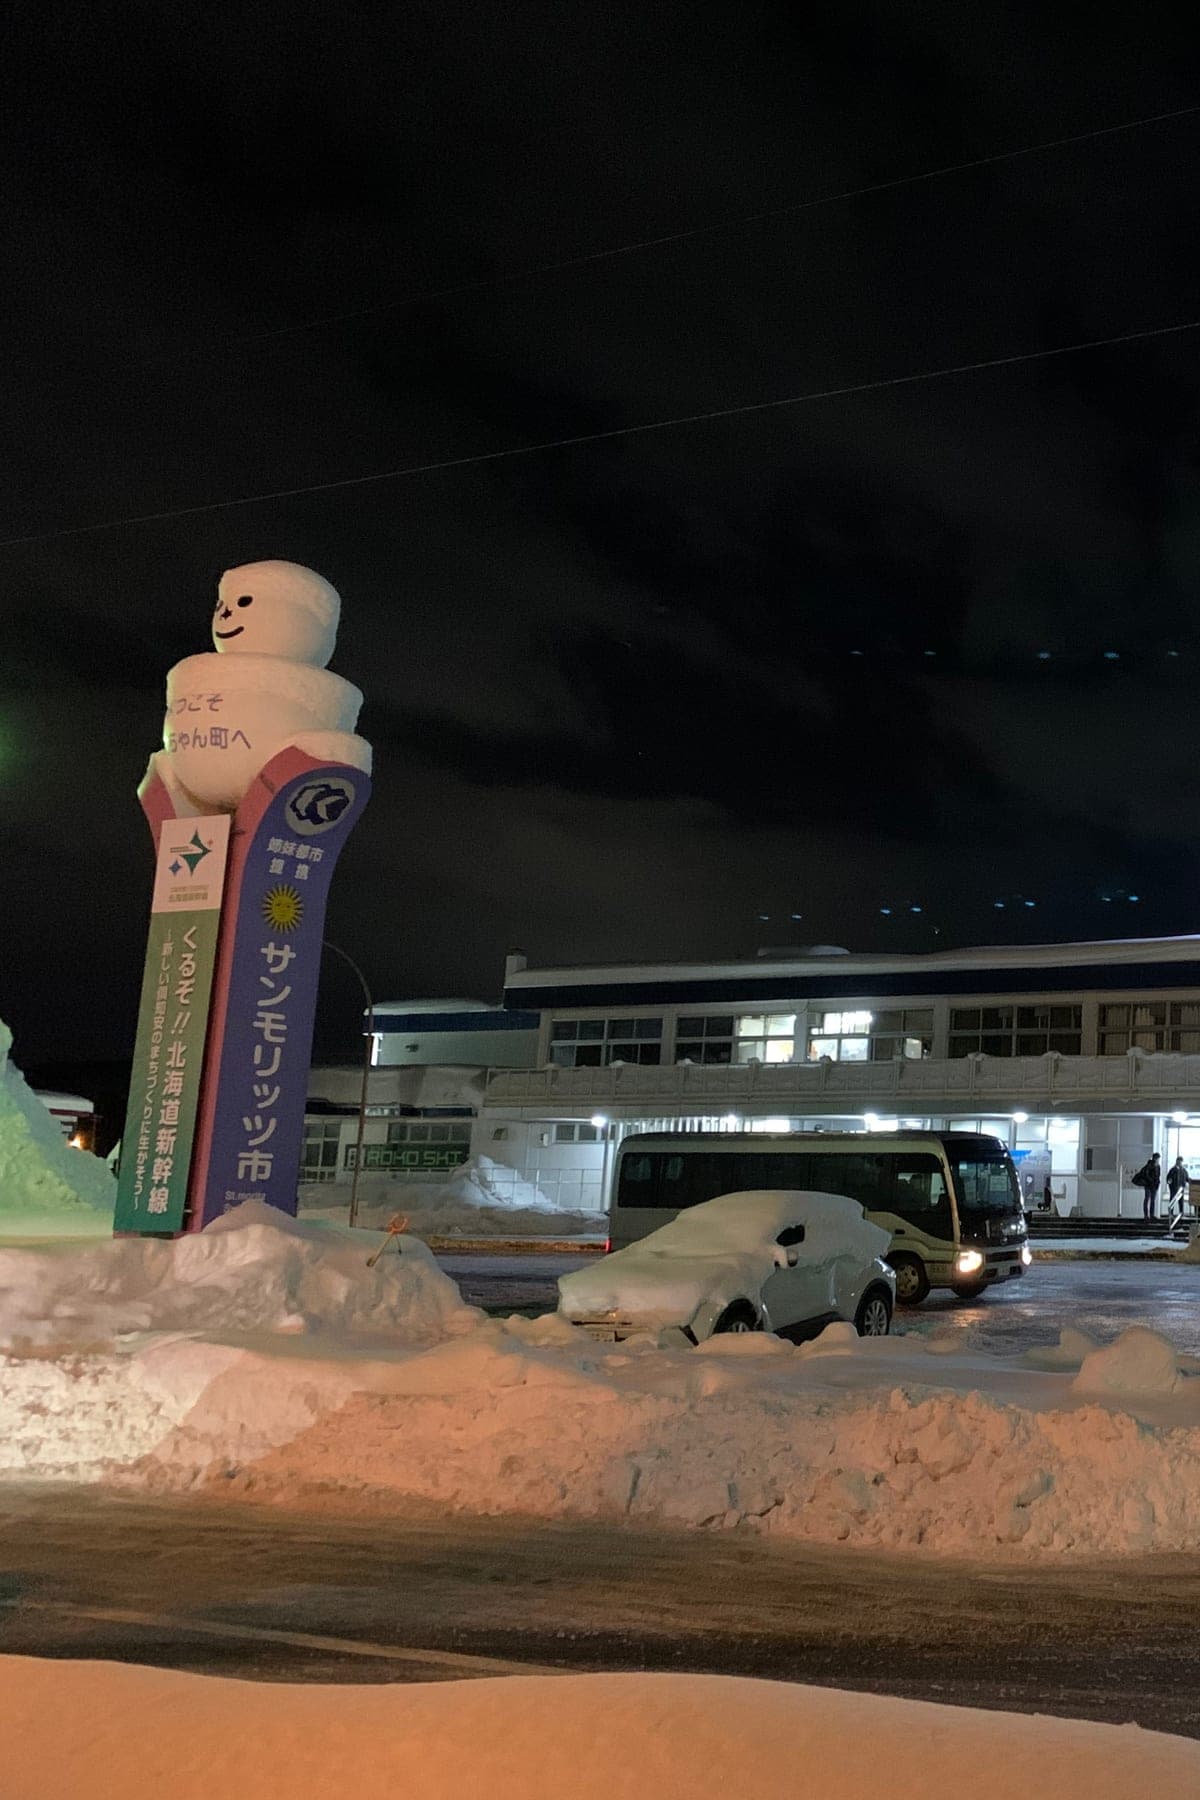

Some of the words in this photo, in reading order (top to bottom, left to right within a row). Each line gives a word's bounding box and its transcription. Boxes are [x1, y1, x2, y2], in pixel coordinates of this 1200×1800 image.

[237, 941, 297, 1183] サンモリッツ市
